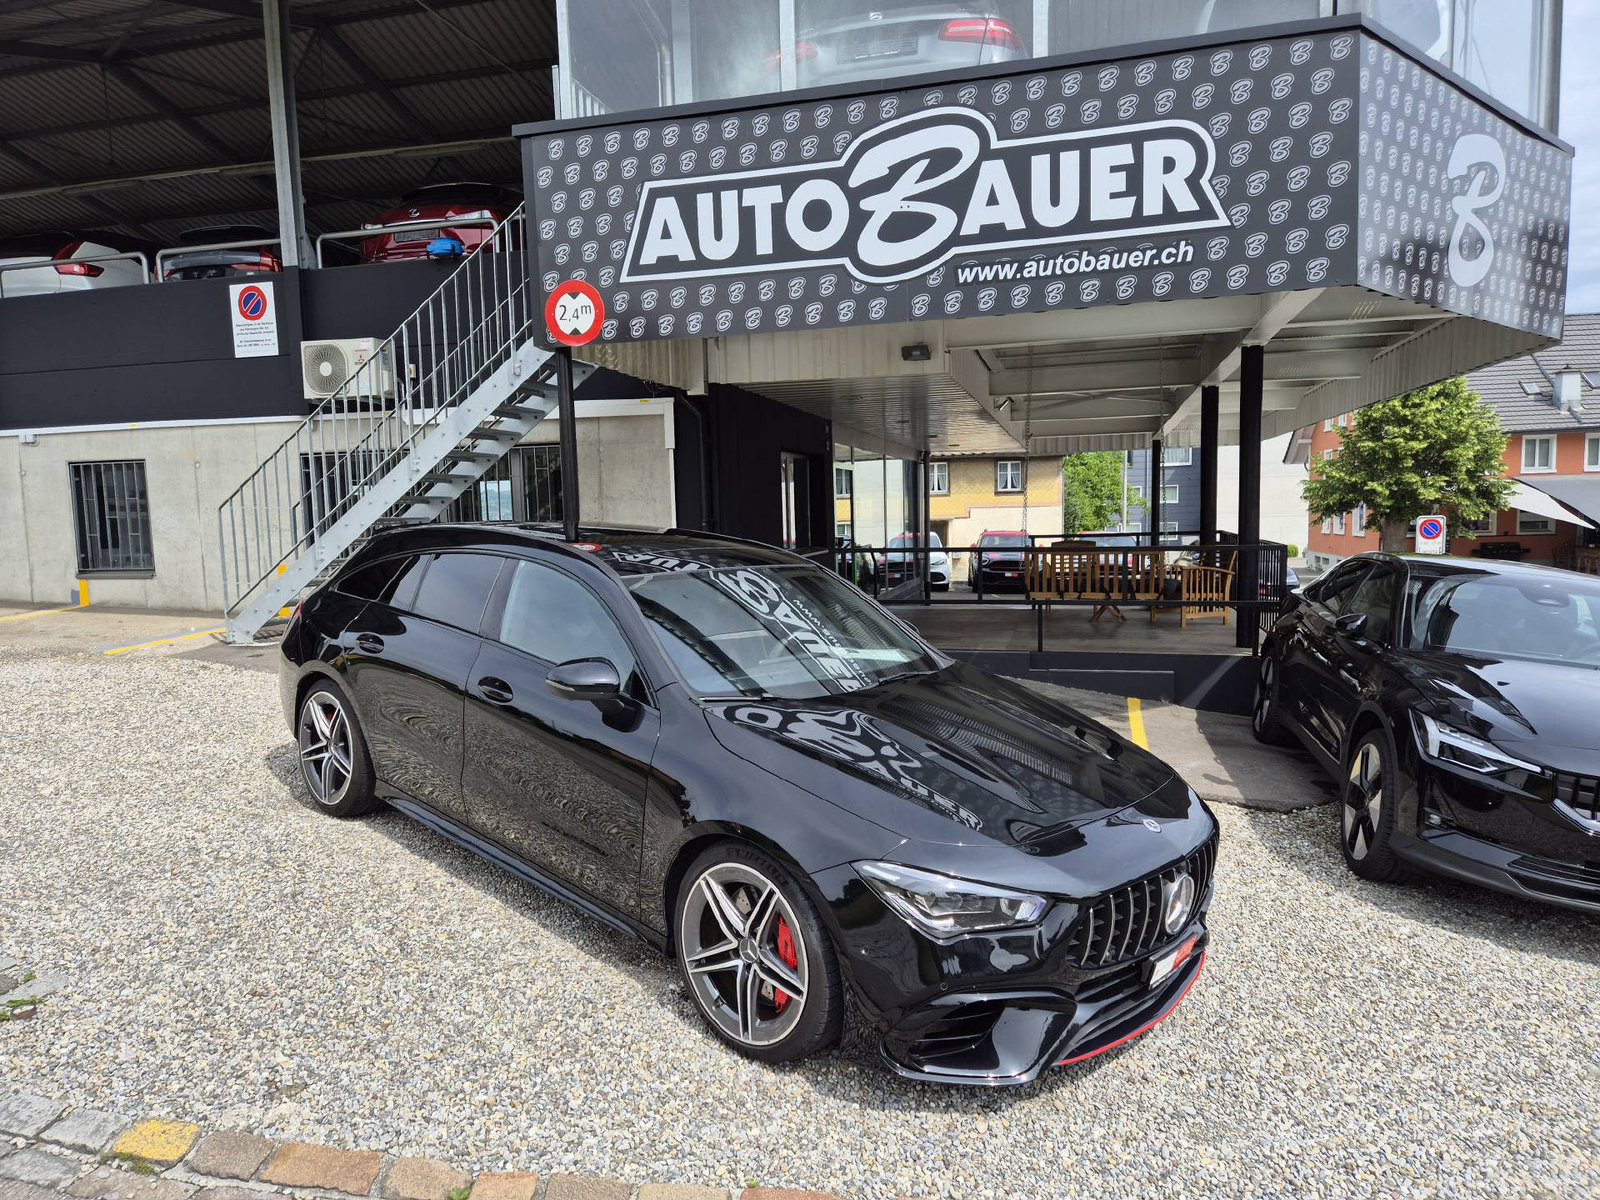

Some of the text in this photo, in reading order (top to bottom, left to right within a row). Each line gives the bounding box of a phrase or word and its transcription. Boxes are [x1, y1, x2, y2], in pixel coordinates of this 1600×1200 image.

[639, 124, 1200, 266] AUTO BAUER
[957, 240, 1195, 284] www.autobauer.ch
